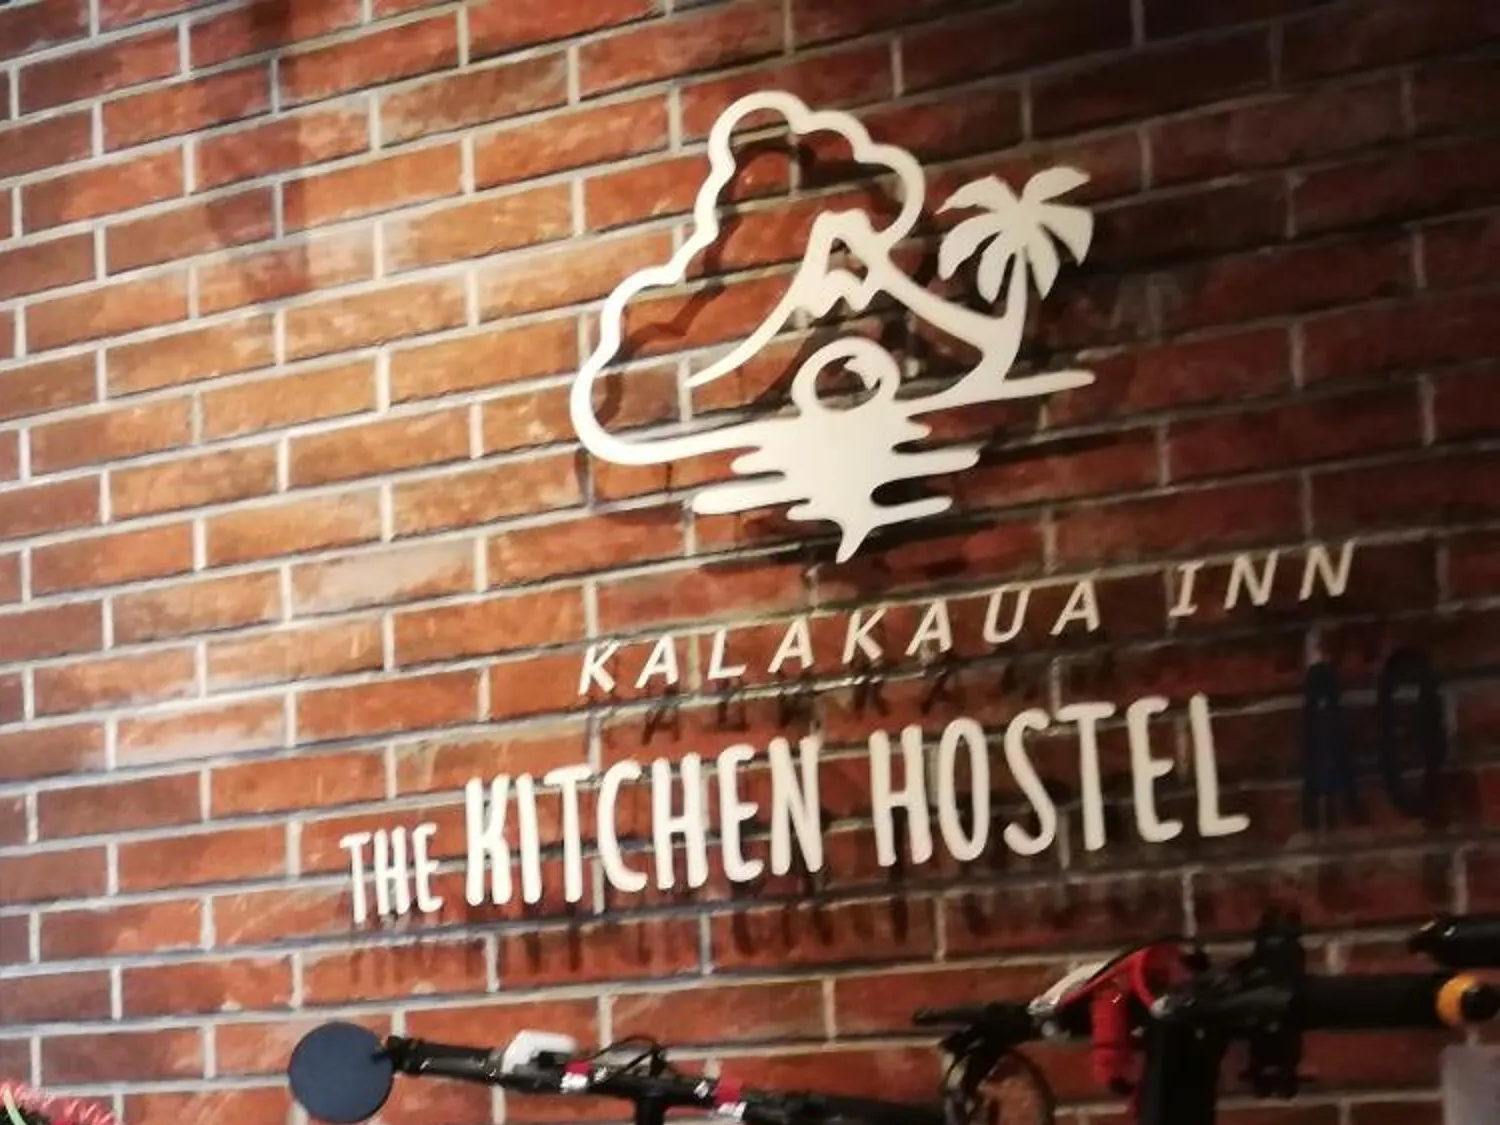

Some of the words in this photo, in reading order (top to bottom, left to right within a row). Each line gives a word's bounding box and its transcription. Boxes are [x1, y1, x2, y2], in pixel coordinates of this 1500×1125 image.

[578, 583, 1102, 695] KALAKAUA
[1168, 540, 1357, 616] INN
[339, 821, 443, 924] THE
[464, 735, 825, 907] KITCHEN
[870, 692, 1250, 867] HOSTEL
